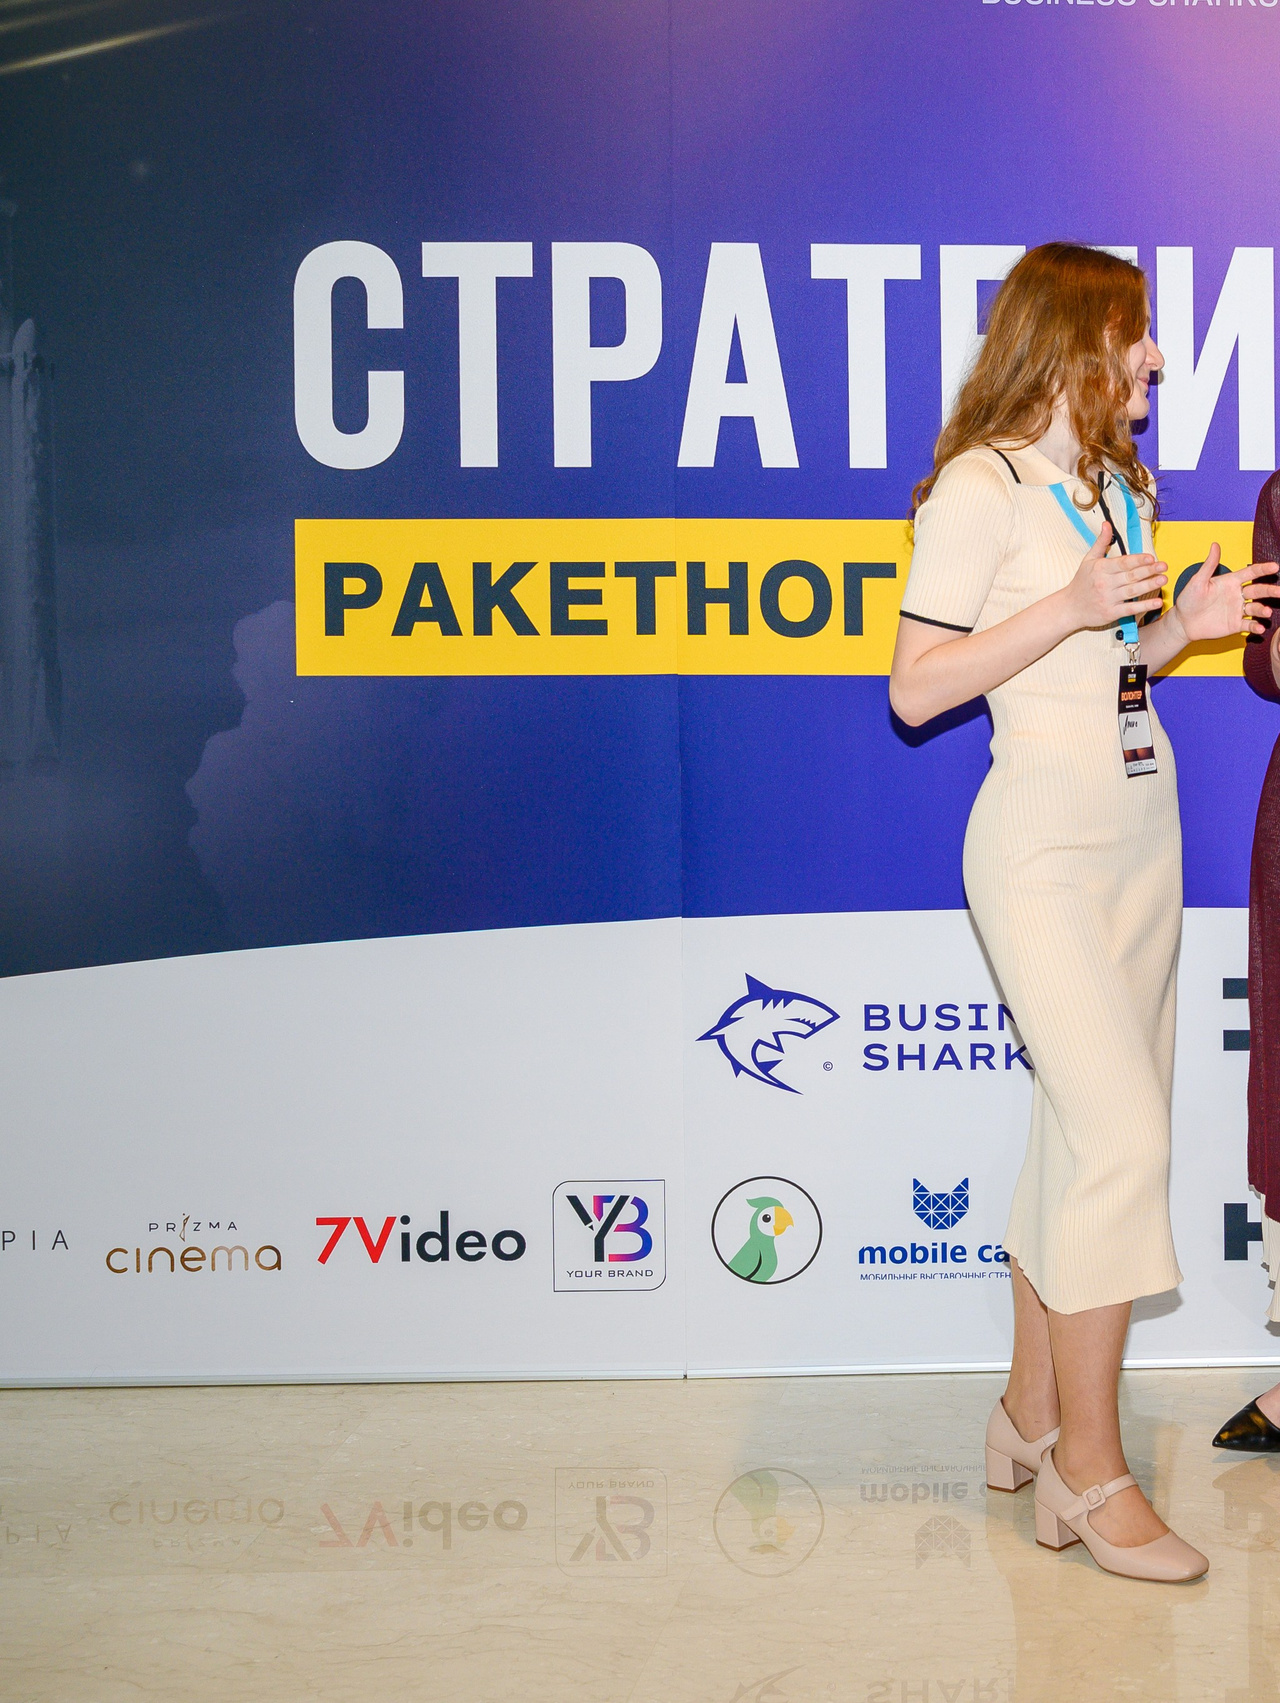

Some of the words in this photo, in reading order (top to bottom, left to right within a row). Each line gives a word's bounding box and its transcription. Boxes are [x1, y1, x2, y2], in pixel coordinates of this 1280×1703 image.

[316, 1211, 526, 1264] 7Video
[105, 1245, 282, 1274] cinema
[858, 1242, 967, 1265] mobile
[567, 1270, 603, 1278] YOUR
[608, 1269, 653, 1277] BRAND
